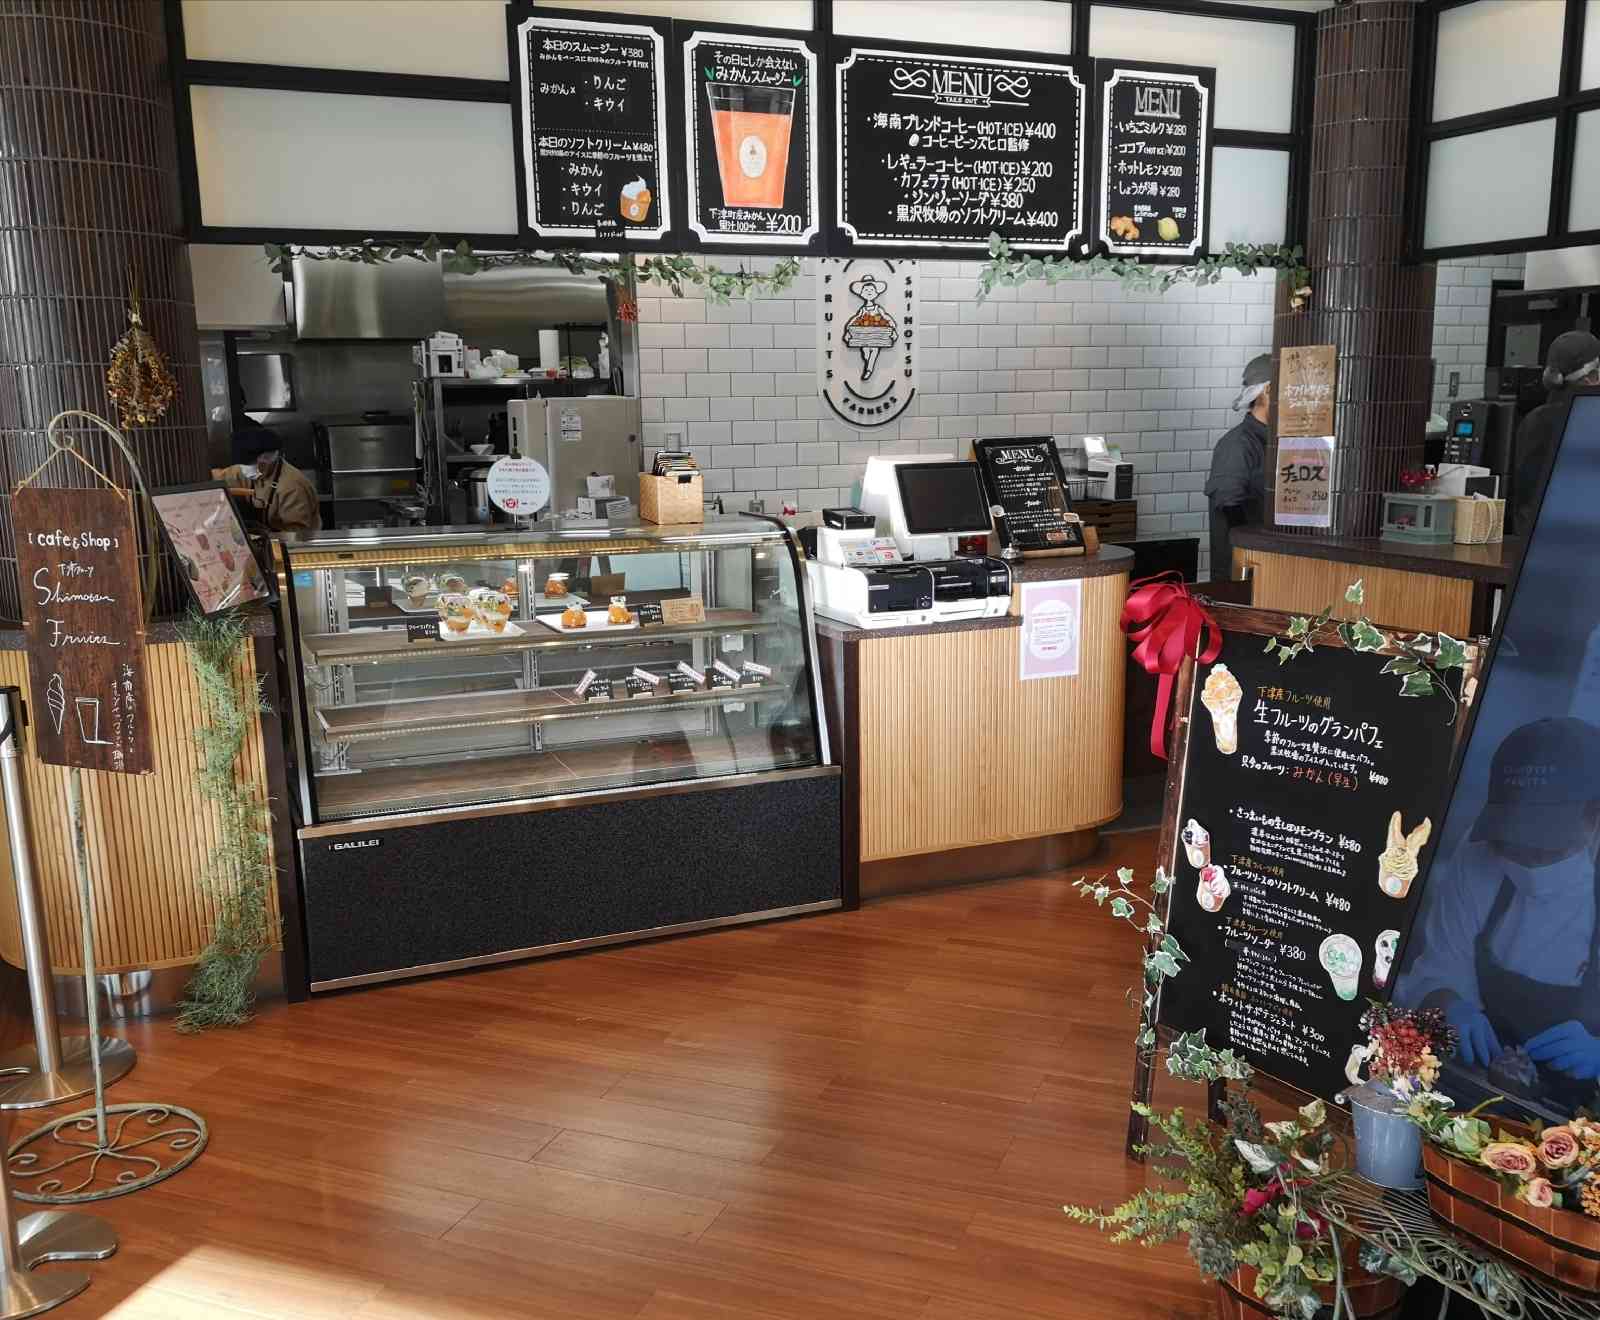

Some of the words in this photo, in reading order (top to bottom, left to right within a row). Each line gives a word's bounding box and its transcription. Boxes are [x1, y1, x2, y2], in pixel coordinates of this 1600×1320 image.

[542, 37, 618, 54] 本日のスムージー
[714, 50, 798, 70] その日にしか会えない
[593, 75, 627, 90] りんご
[715, 65, 792, 85] みかんスムージー
[931, 69, 993, 97] MENU
[593, 97, 625, 112] キウイ
[1134, 86, 1181, 119] MENU
[568, 162, 603, 177] みかん
[570, 182, 602, 197] キウイ
[571, 201, 605, 216] りんご
[766, 212, 802, 233] ¥200
[824, 274, 834, 379] FRUITS
[1280, 463, 1326, 483] チュロス
[1253, 699, 1384, 749] 生フルーツのグランパフェ
[334, 839, 380, 851] GALILEI
[1338, 833, 1361, 853] ¥580
[1325, 891, 1351, 912] ¥480
[1279, 944, 1306, 961] ¥380
